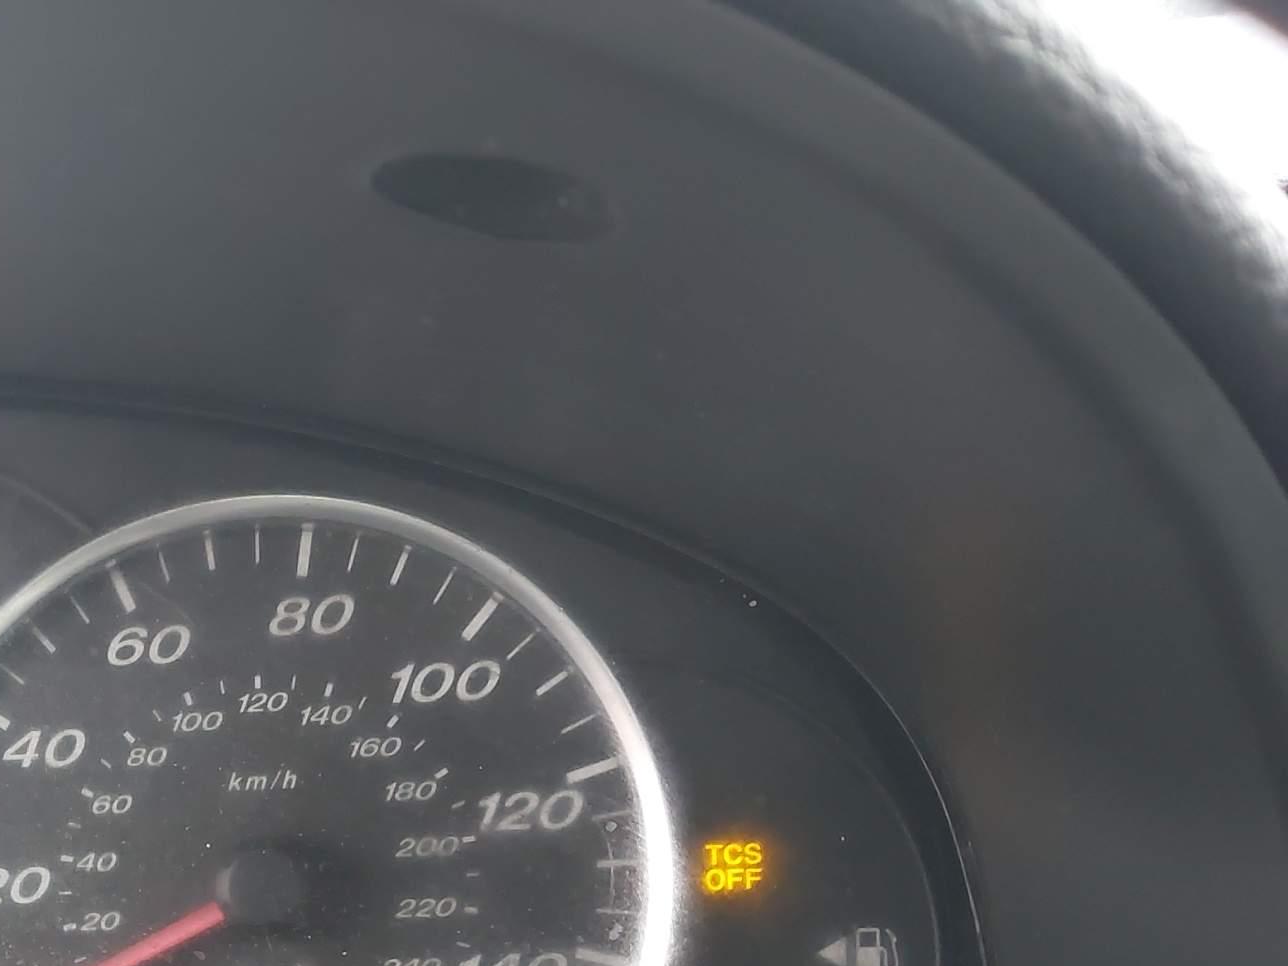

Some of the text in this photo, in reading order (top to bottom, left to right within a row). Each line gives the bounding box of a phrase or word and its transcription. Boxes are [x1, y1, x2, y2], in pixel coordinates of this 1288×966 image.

[268, 594, 355, 637] 80
[106, 624, 191, 667] 60
[390, 660, 501, 704] 100
[237, 691, 289, 713] 120
[171, 711, 224, 733] 100
[300, 704, 353, 727] 140
[2, 728, 86, 768] 40
[126, 747, 168, 768] 80
[350, 736, 402, 759] 160
[227, 769, 298, 793] km/h
[384, 781, 438, 803] 180
[91, 794, 133, 816] 60
[476, 790, 585, 832] 120
[394, 836, 460, 858] 200
[705, 842, 763, 866] TCS
[75, 852, 118, 874] 40
[704, 867, 763, 893] OFF
[394, 898, 458, 919] 220
[79, 911, 121, 933] 20
